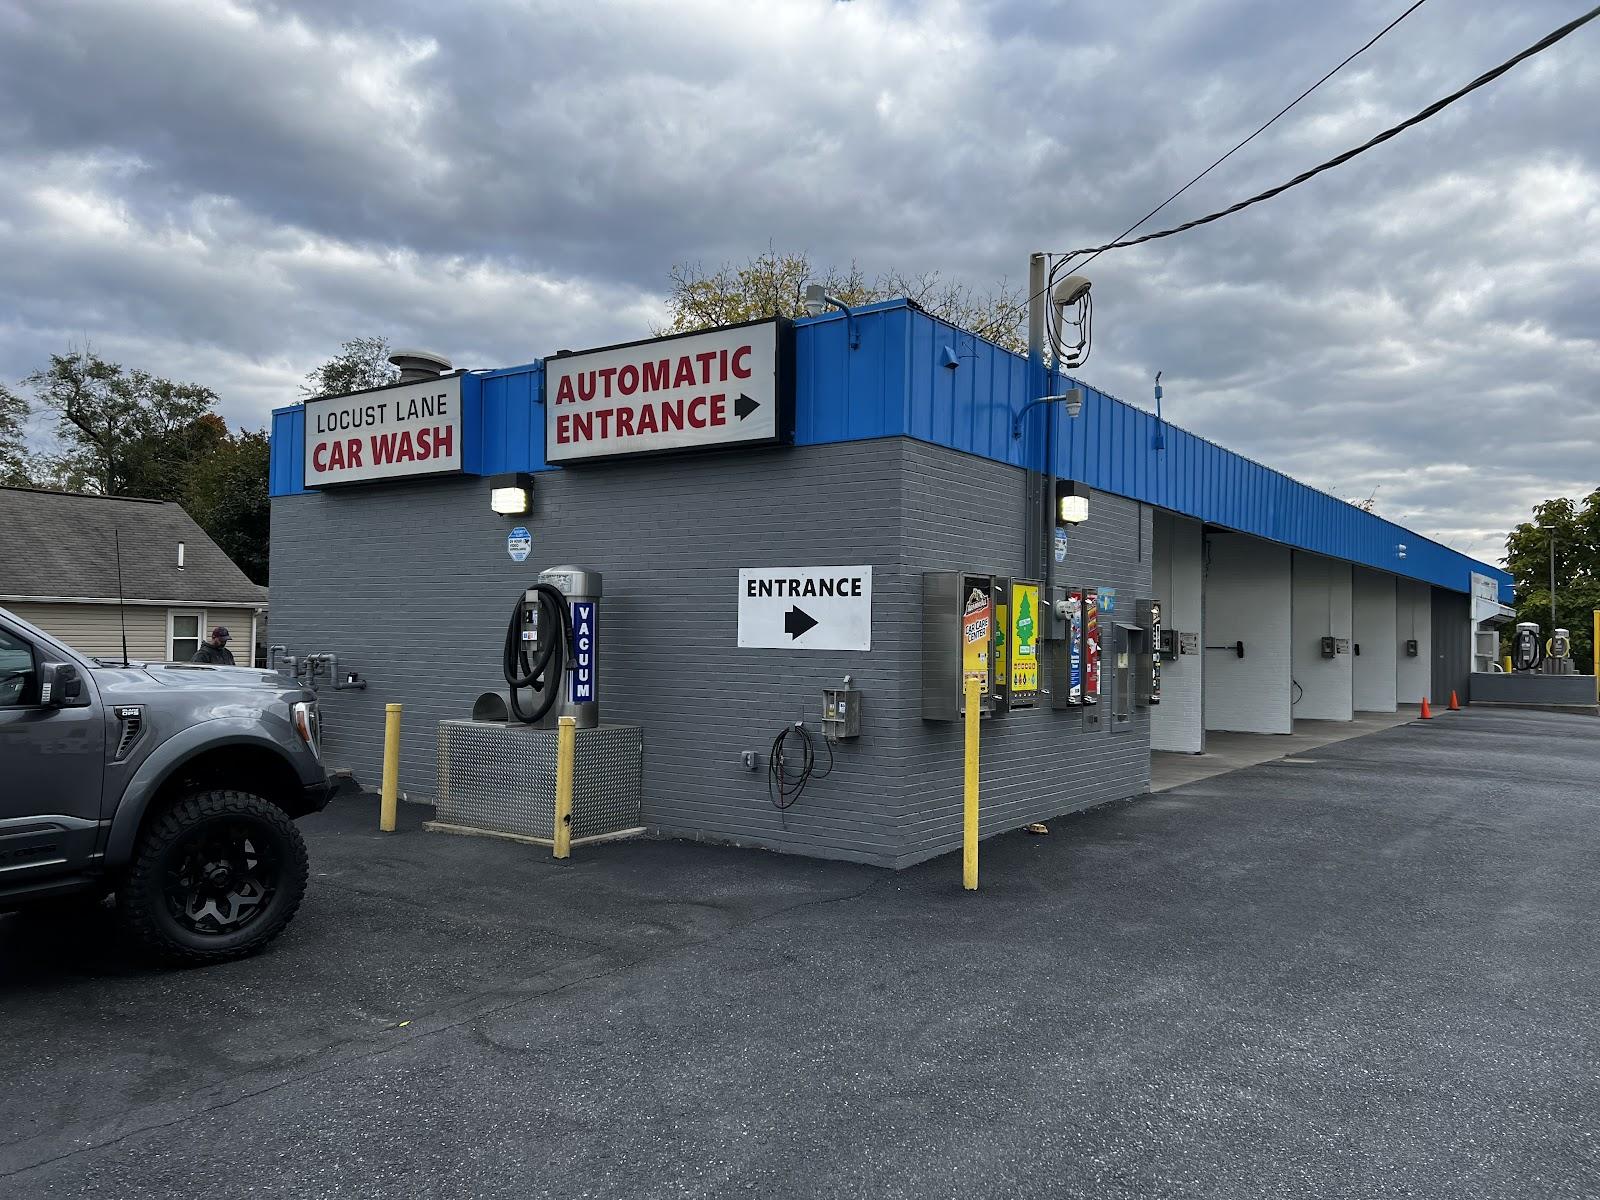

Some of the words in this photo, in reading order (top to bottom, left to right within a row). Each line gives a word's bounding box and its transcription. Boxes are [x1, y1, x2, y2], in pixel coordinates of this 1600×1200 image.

[555, 345, 752, 405] AUTOMATIC
[317, 403, 387, 434] LOCUST
[396, 393, 447, 422] LANE
[556, 393, 726, 445] ENTRANCE
[312, 438, 363, 473] CAR
[370, 425, 453, 466] WASH
[747, 577, 862, 598] ENTRANCE
[965, 622, 975, 635] CAR
[976, 617, 988, 630] CARE
[968, 627, 986, 643] CENTER
[576, 606, 590, 697] VACUUM
